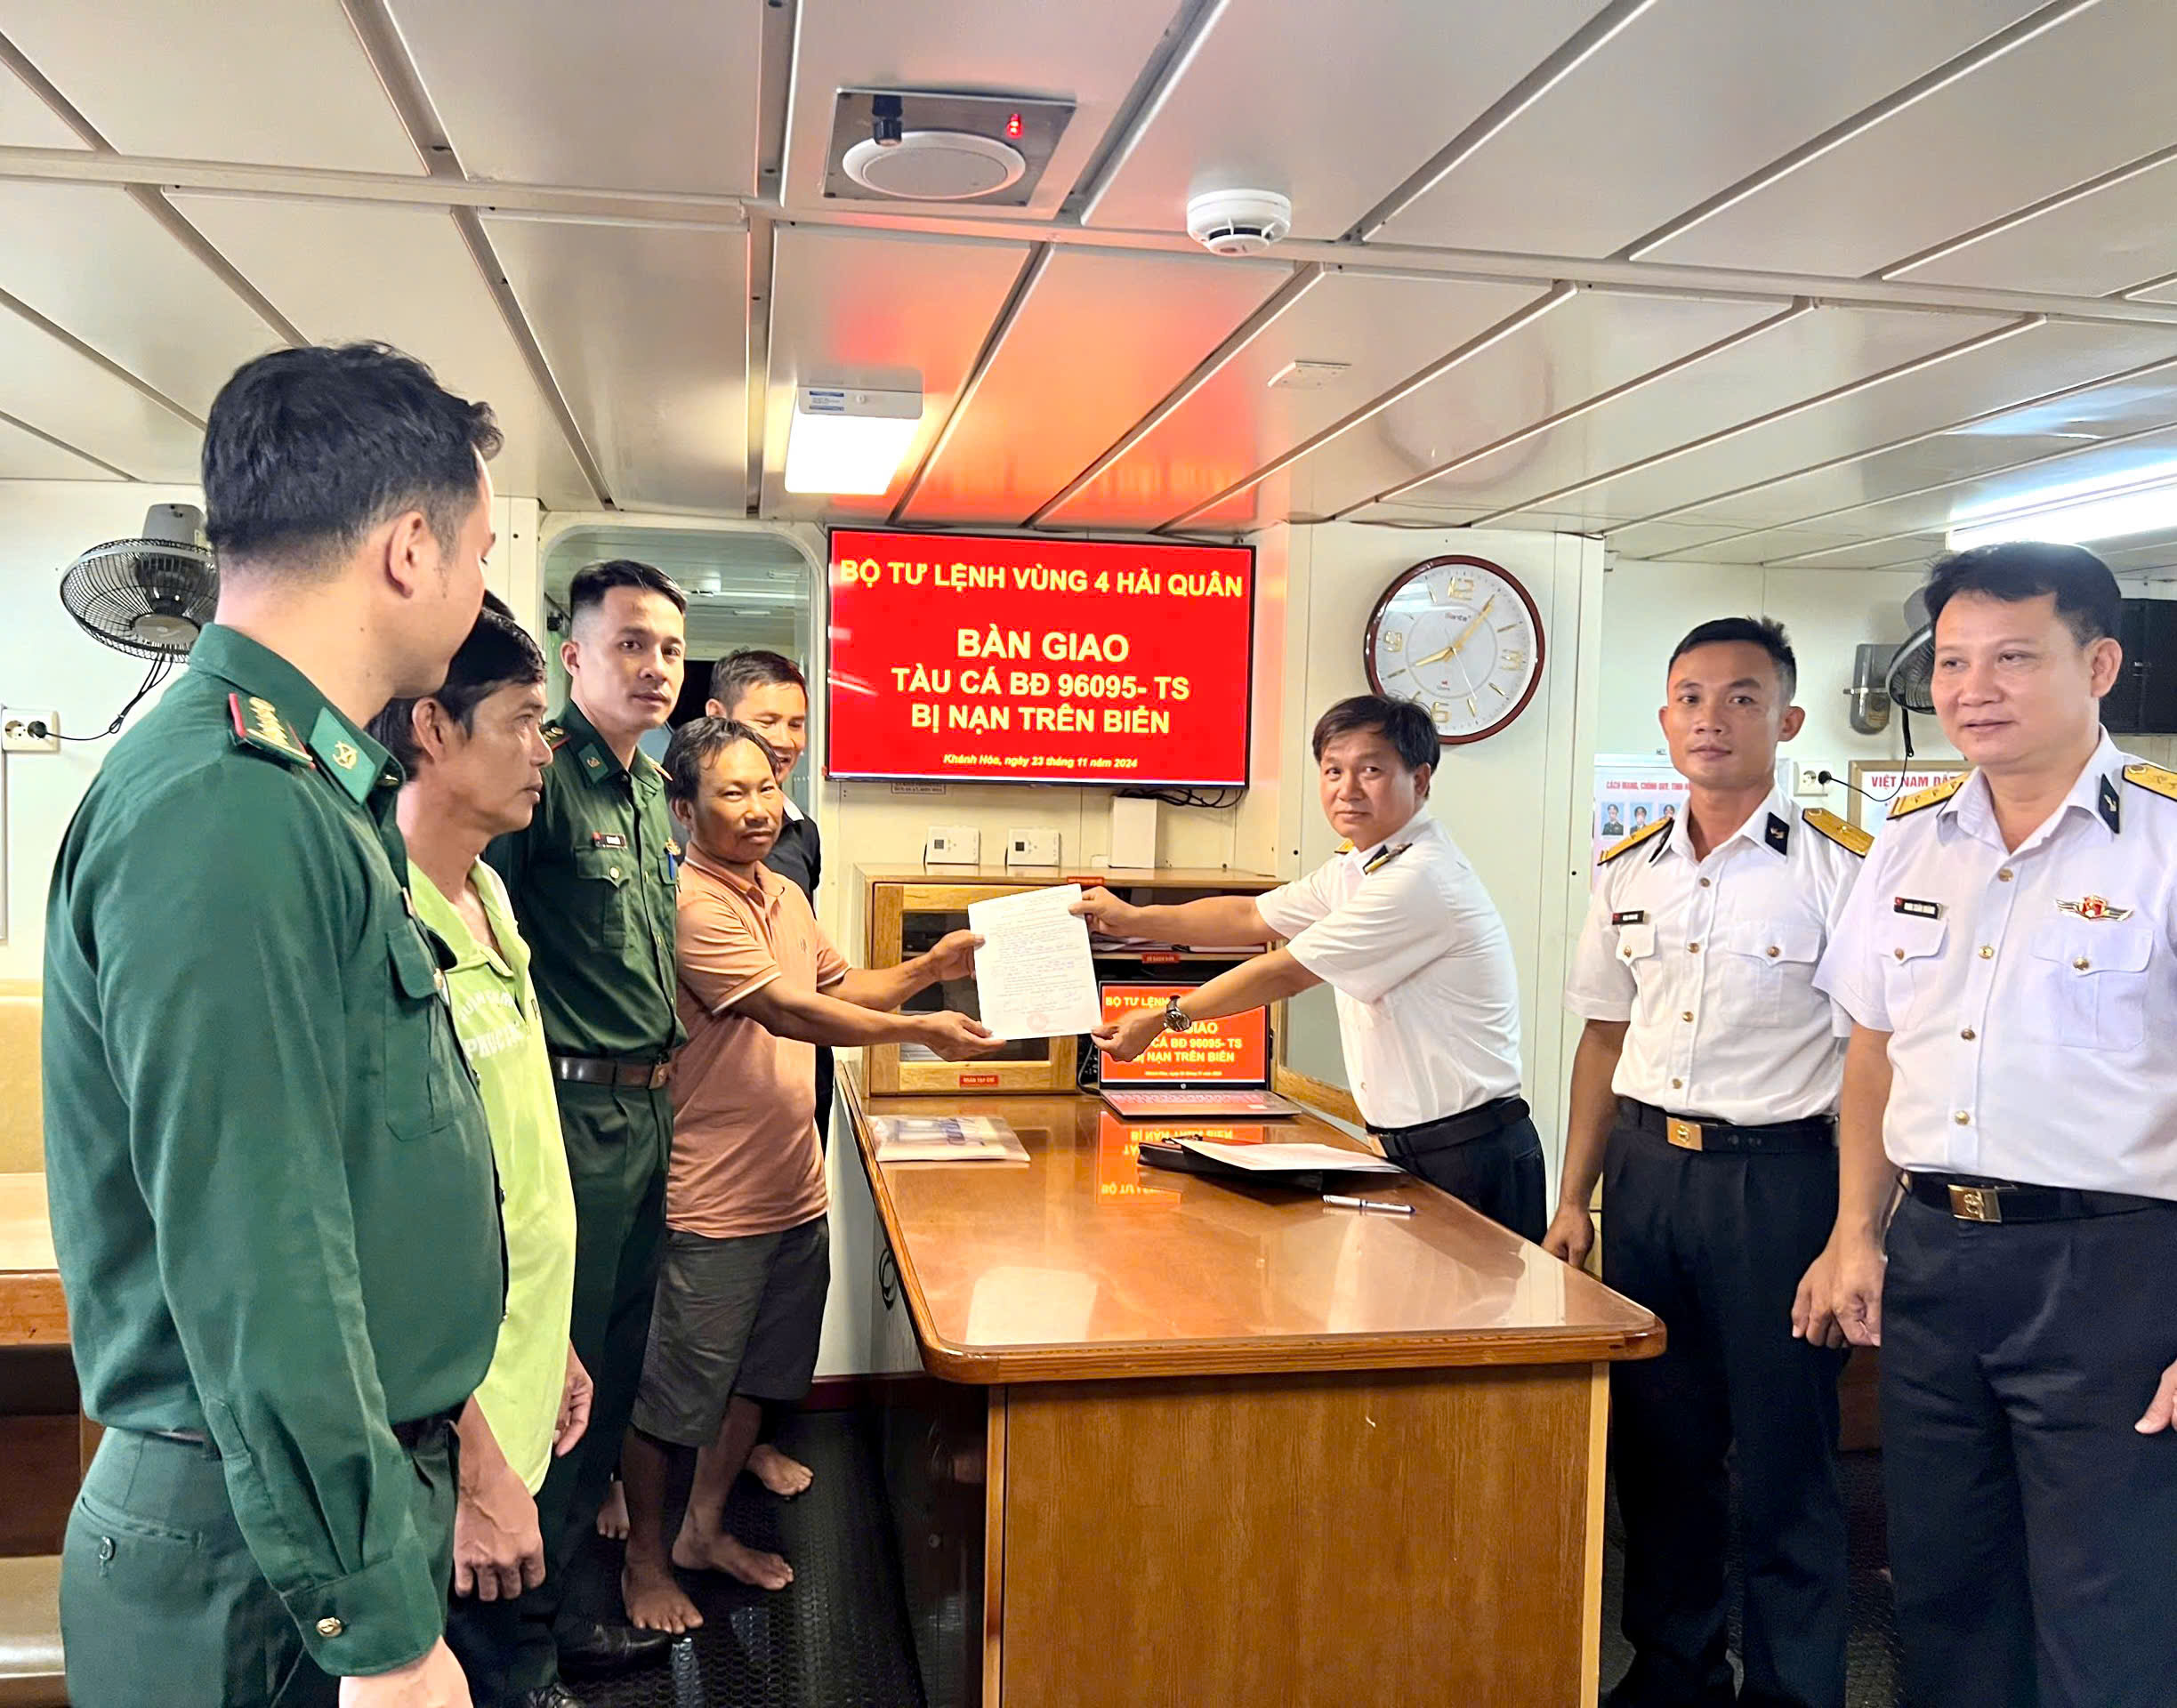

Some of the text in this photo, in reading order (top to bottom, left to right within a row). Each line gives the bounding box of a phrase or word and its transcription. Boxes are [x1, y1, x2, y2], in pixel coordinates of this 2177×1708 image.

[840, 559, 1243, 598] BỘ TƯ LỆNH VÙNG 4 HẢI QUÂN
[957, 623, 1129, 663] BÀN GIAO
[891, 663, 951, 693] TÀU
[960, 665, 1002, 695] CÁ
[1010, 672, 1051, 697] BĐ
[1153, 676, 1189, 700] TS
[911, 704, 939, 734] BỊ
[948, 705, 1010, 735] NẠN
[1017, 703, 1095, 732] TRÊN
[942, 753, 978, 765] Khánh
[1045, 756, 1076, 769] tháng
[1076, 757, 1088, 768] 11
[1113, 758, 1138, 769] 2024
[1871, 773, 1897, 790] VIỆT
[1903, 776, 1929, 787] NAM
